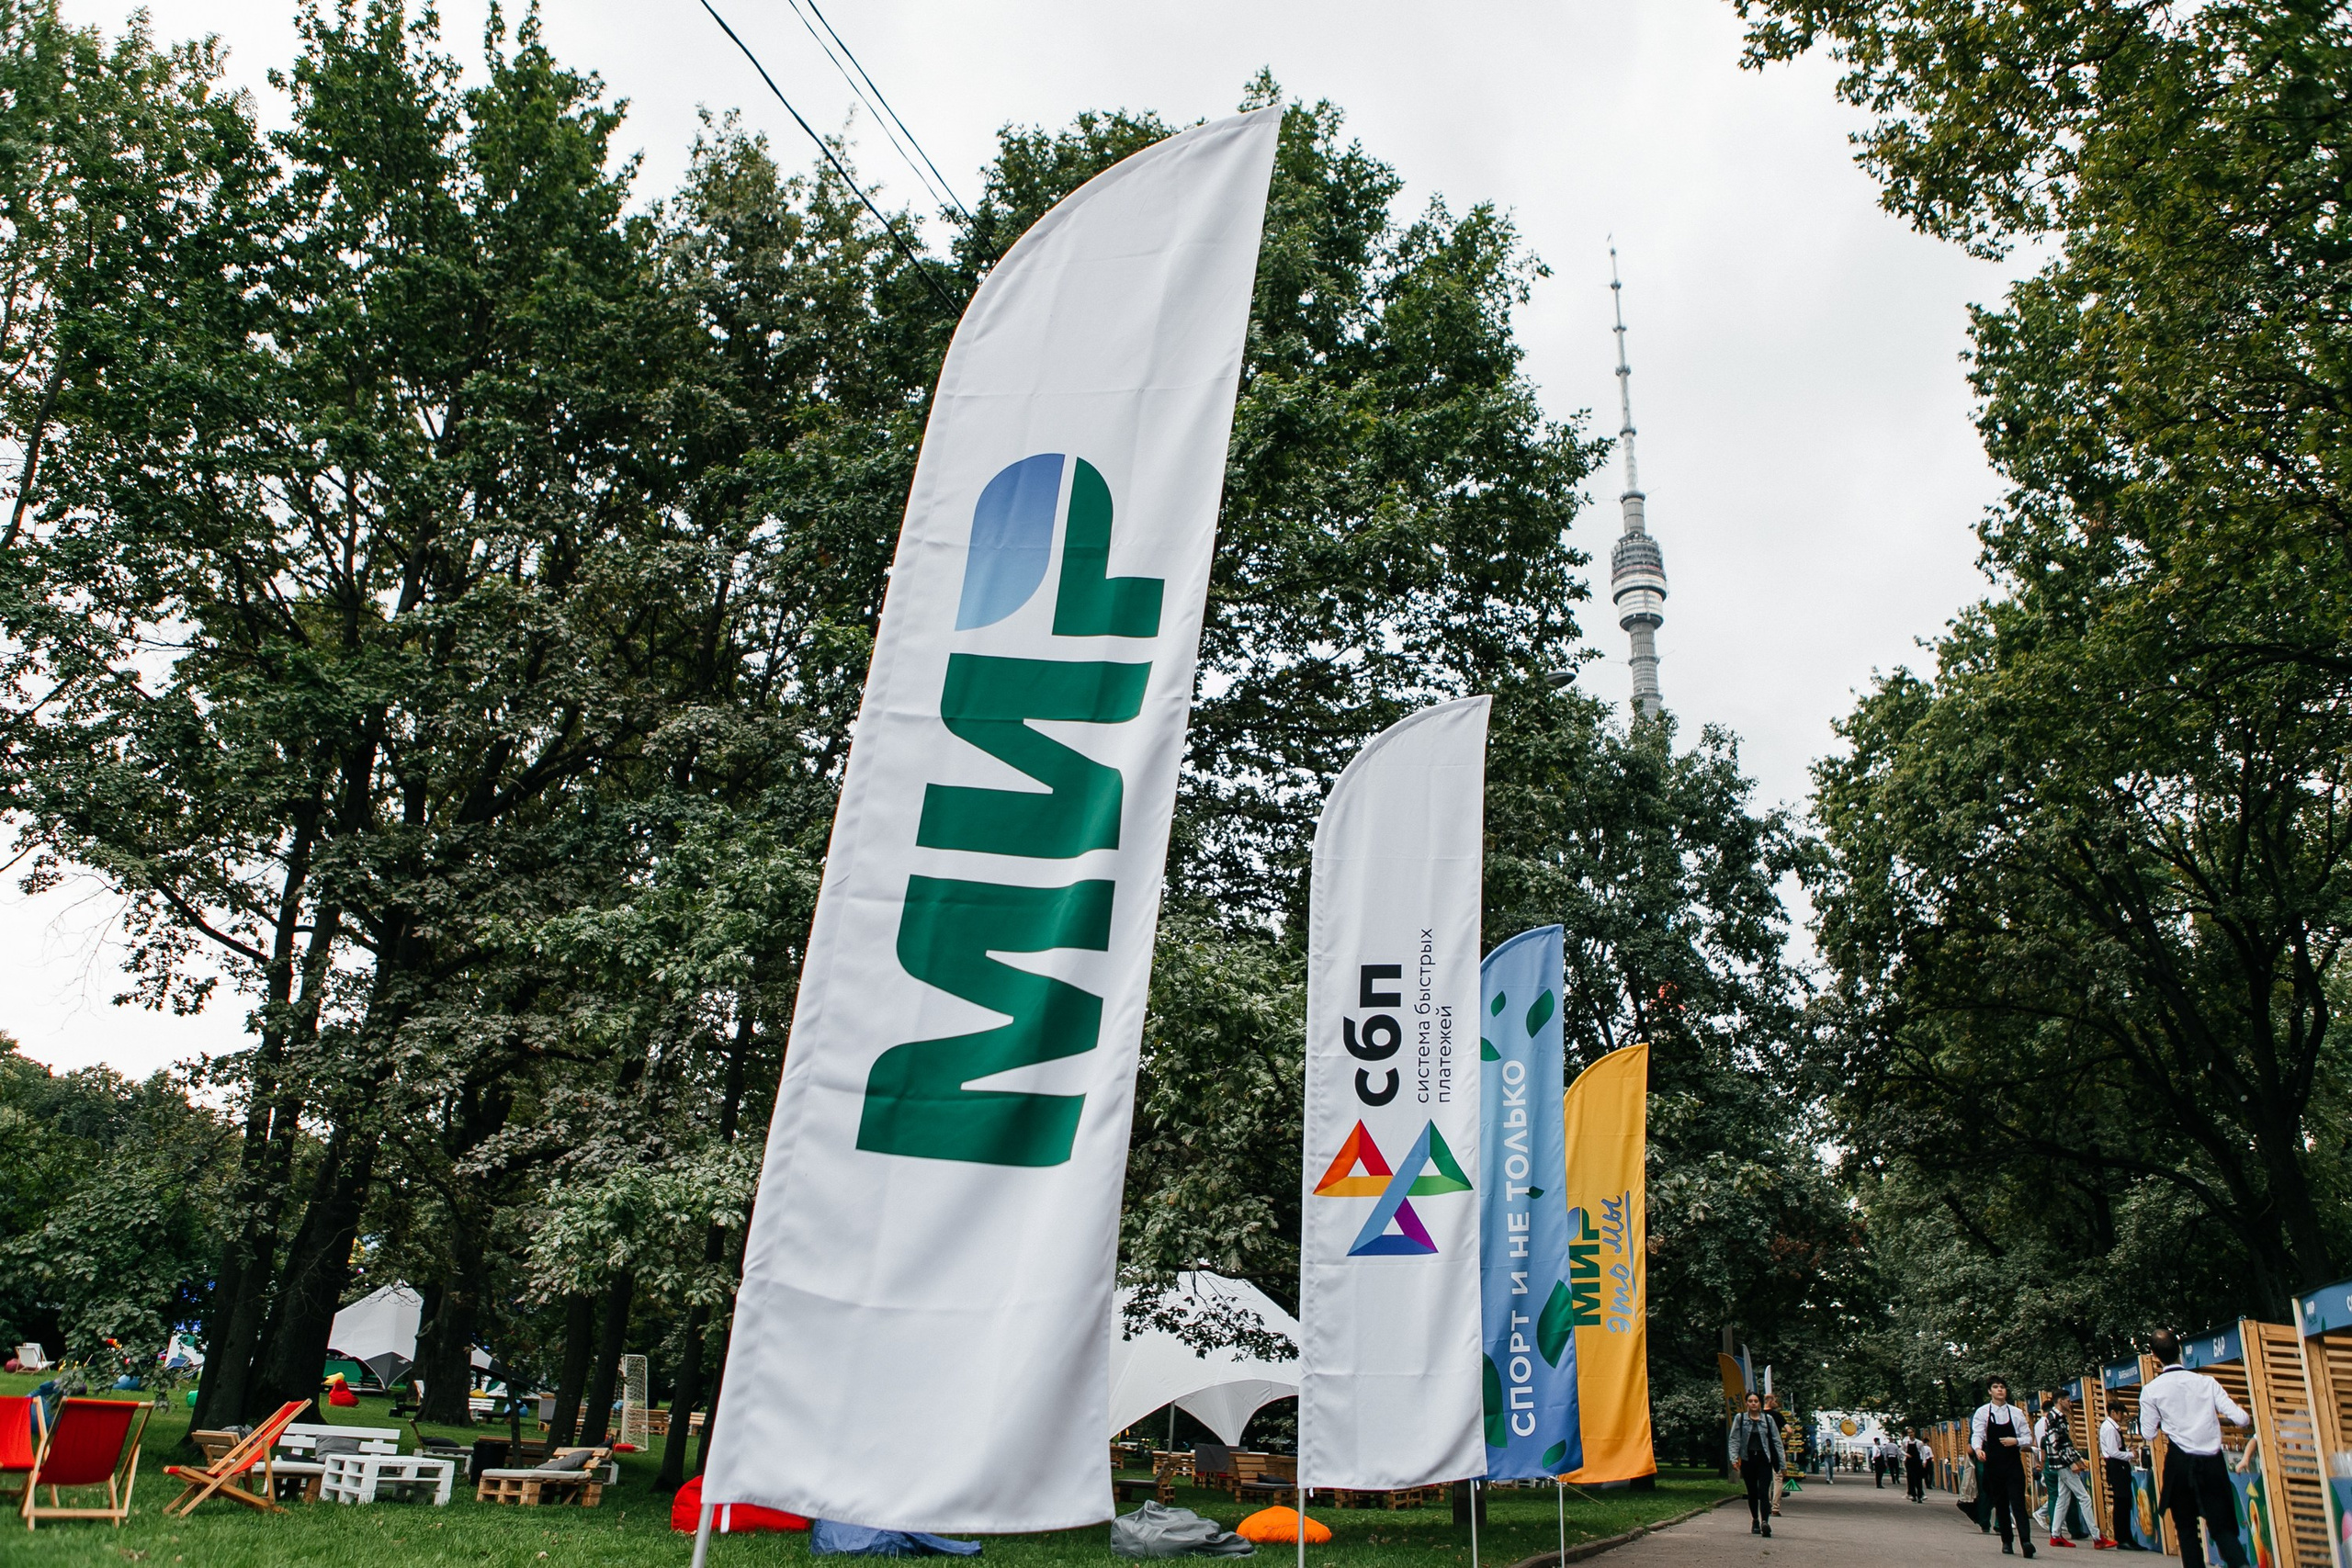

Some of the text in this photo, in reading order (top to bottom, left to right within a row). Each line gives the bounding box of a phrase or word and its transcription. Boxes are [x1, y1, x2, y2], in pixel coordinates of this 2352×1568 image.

[855, 453, 1165, 1167] МИР
[1343, 964, 1402, 1107] сбп
[1414, 928, 1436, 1103] система быстрых
[1435, 1005, 1453, 1102] платежей
[1502, 1060, 1536, 1437] СПОРТ И НЕ ТОЛЬКО
[1567, 1206, 1601, 1325] МИР
[1600, 1194, 1633, 1334] это мы
[2212, 1336, 2225, 1358] БАР
